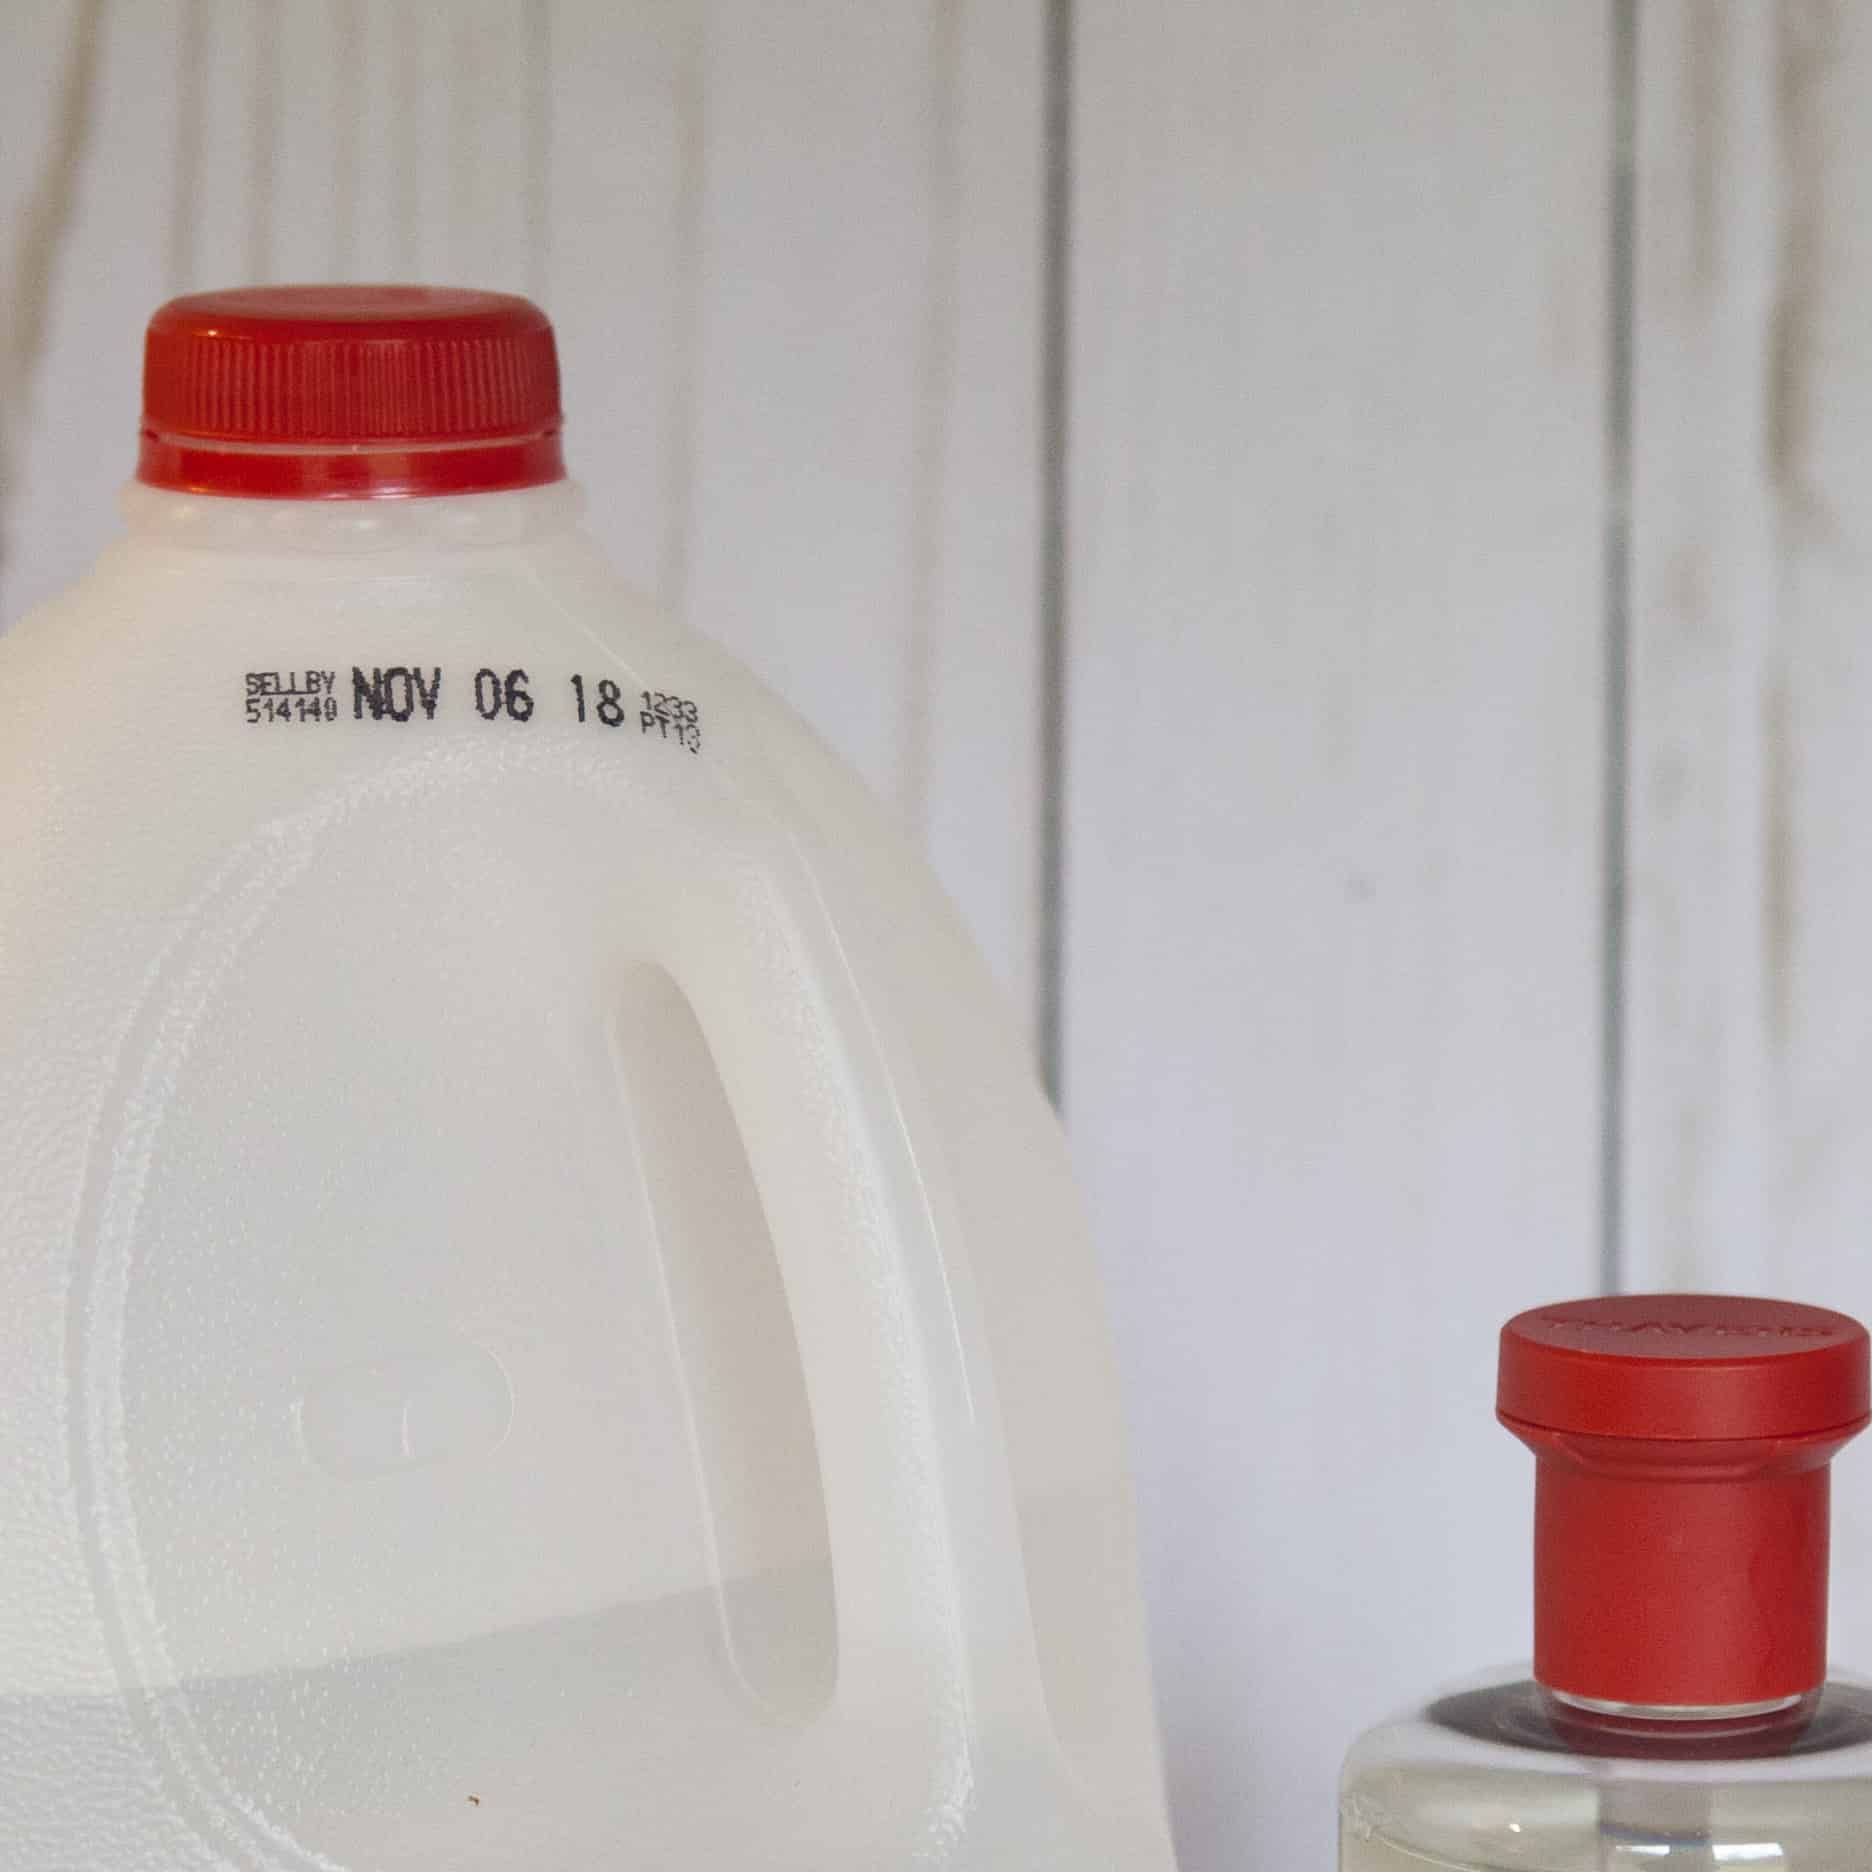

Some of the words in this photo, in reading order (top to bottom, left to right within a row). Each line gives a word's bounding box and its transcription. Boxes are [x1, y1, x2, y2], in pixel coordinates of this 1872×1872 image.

[351, 665, 442, 722] NOV
[474, 668, 535, 722] 06
[570, 673, 625, 727] 18
